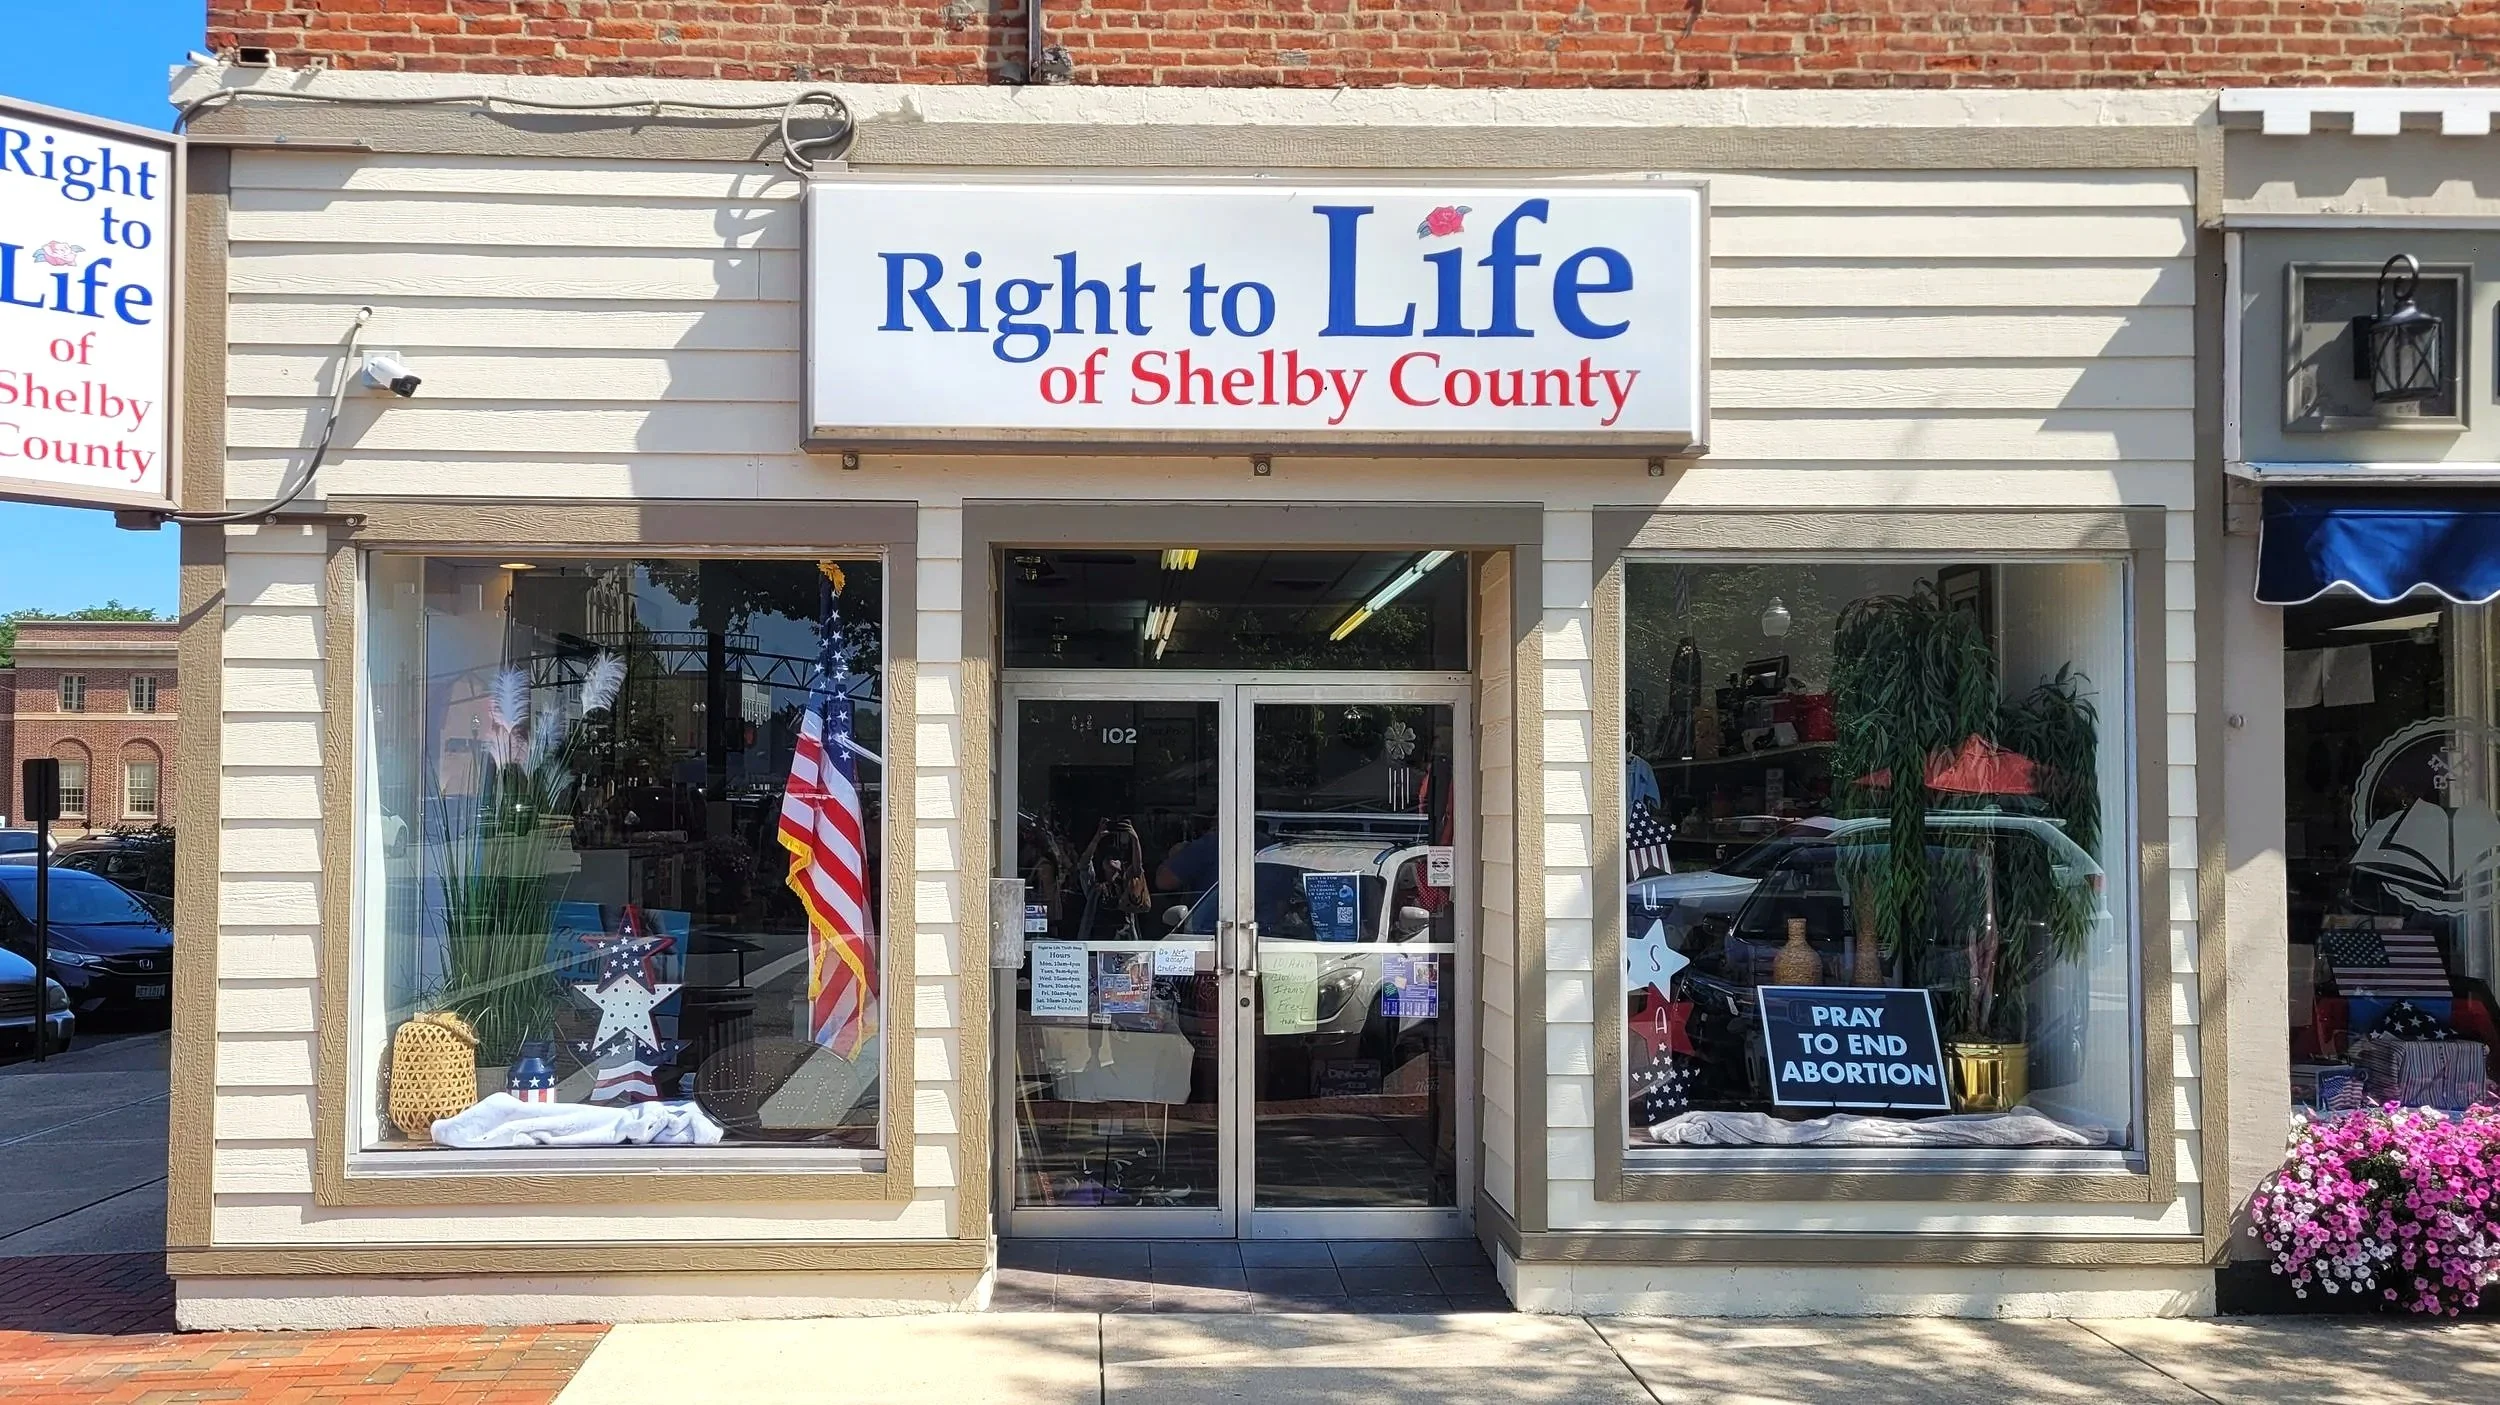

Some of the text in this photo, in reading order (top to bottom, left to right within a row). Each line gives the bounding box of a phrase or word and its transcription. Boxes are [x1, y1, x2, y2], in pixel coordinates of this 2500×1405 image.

[0, 127, 157, 201] Right
[100, 207, 152, 249] to
[0, 242, 153, 325] Life
[879, 199, 1633, 362] Right to Life
[50, 331, 97, 365] of
[0, 369, 153, 432] Shelby
[1039, 347, 1640, 427] of Shelby County
[1102, 728, 1137, 744] 102
[1049, 951, 1071, 959] Hours
[1811, 1006, 1885, 1028] PRAY
[1798, 1033, 1908, 1056] TO END
[708, 1067, 847, 1115] OPEN
[1781, 1060, 1937, 1086] ABORTION
